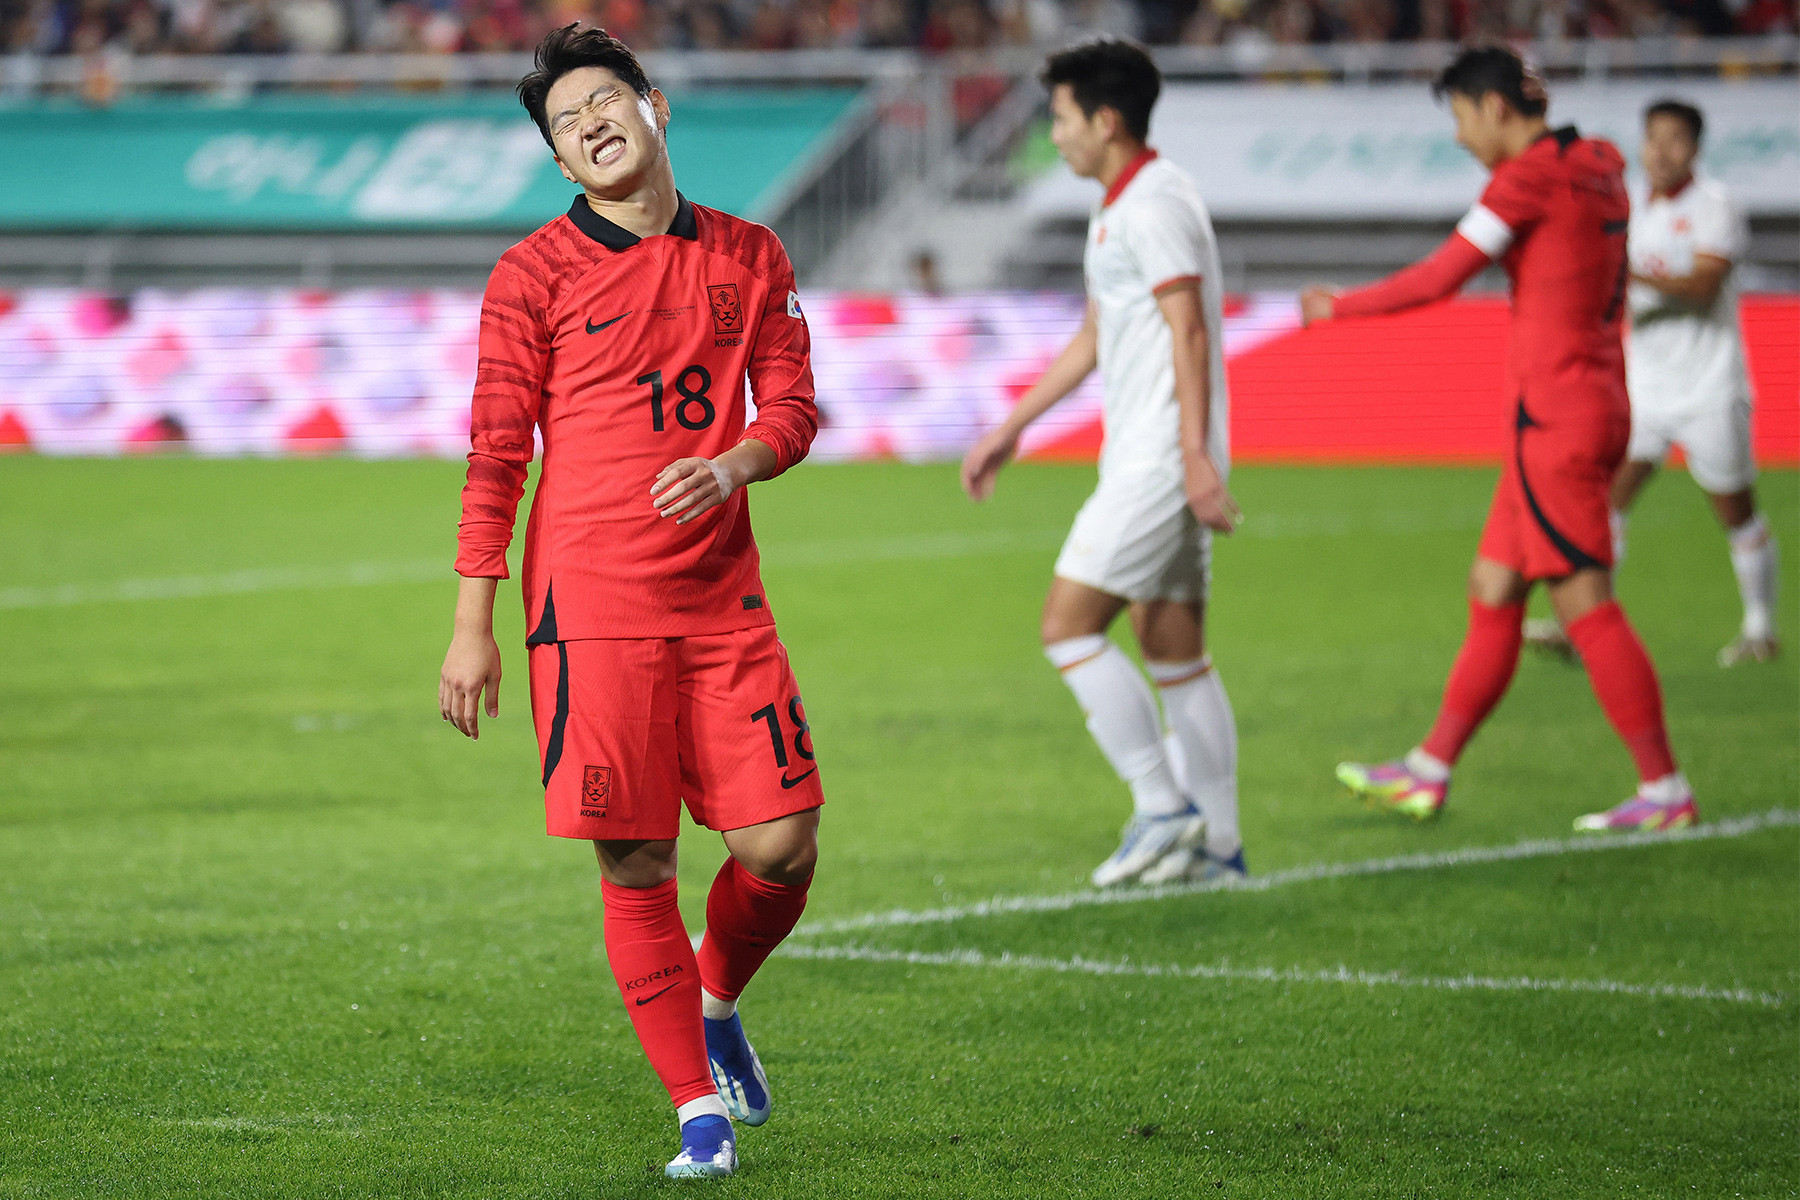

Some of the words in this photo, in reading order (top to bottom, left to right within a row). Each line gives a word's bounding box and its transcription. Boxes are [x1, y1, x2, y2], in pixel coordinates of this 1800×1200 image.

[714, 337, 744, 348] KOREA
[637, 364, 715, 432] 18
[750, 695, 816, 768] 18
[580, 808, 607, 819] KOREA
[625, 964, 684, 991] KOREA
